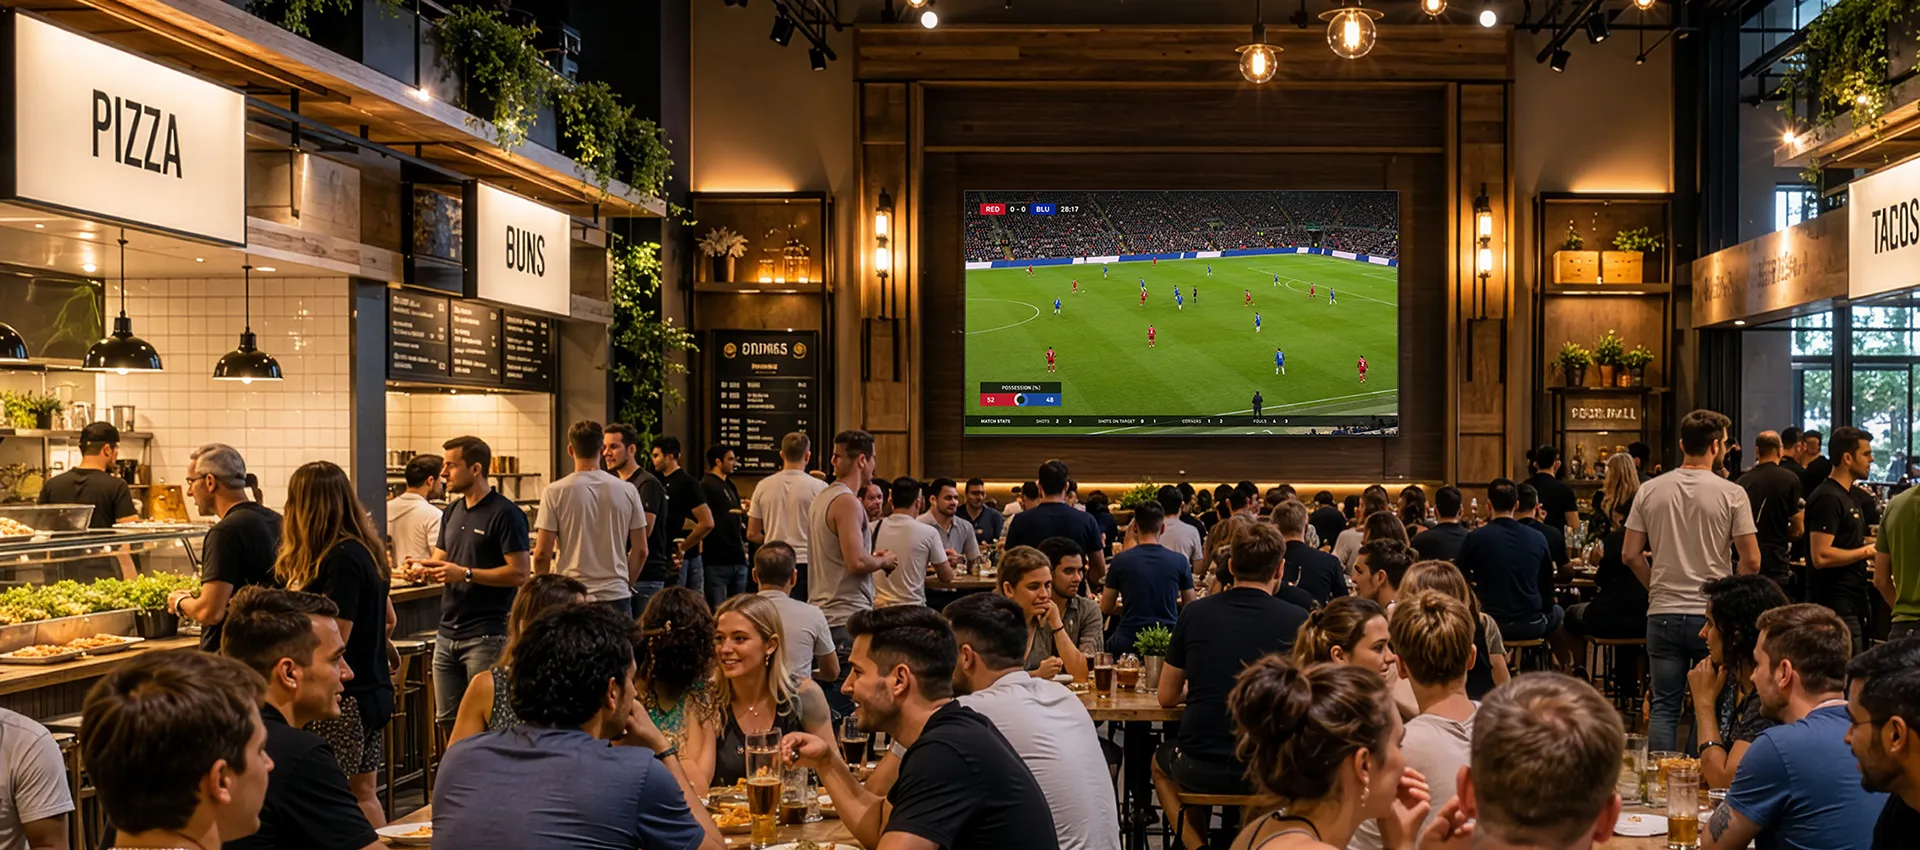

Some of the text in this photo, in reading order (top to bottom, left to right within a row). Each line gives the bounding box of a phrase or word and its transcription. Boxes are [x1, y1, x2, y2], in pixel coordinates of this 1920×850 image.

[93, 88, 182, 179] PIZZA
[1009, 205, 1015, 213] 0
[1020, 205, 1026, 213] 0
[1872, 197, 1919, 254] TACOS
[506, 224, 545, 278] BUNS
